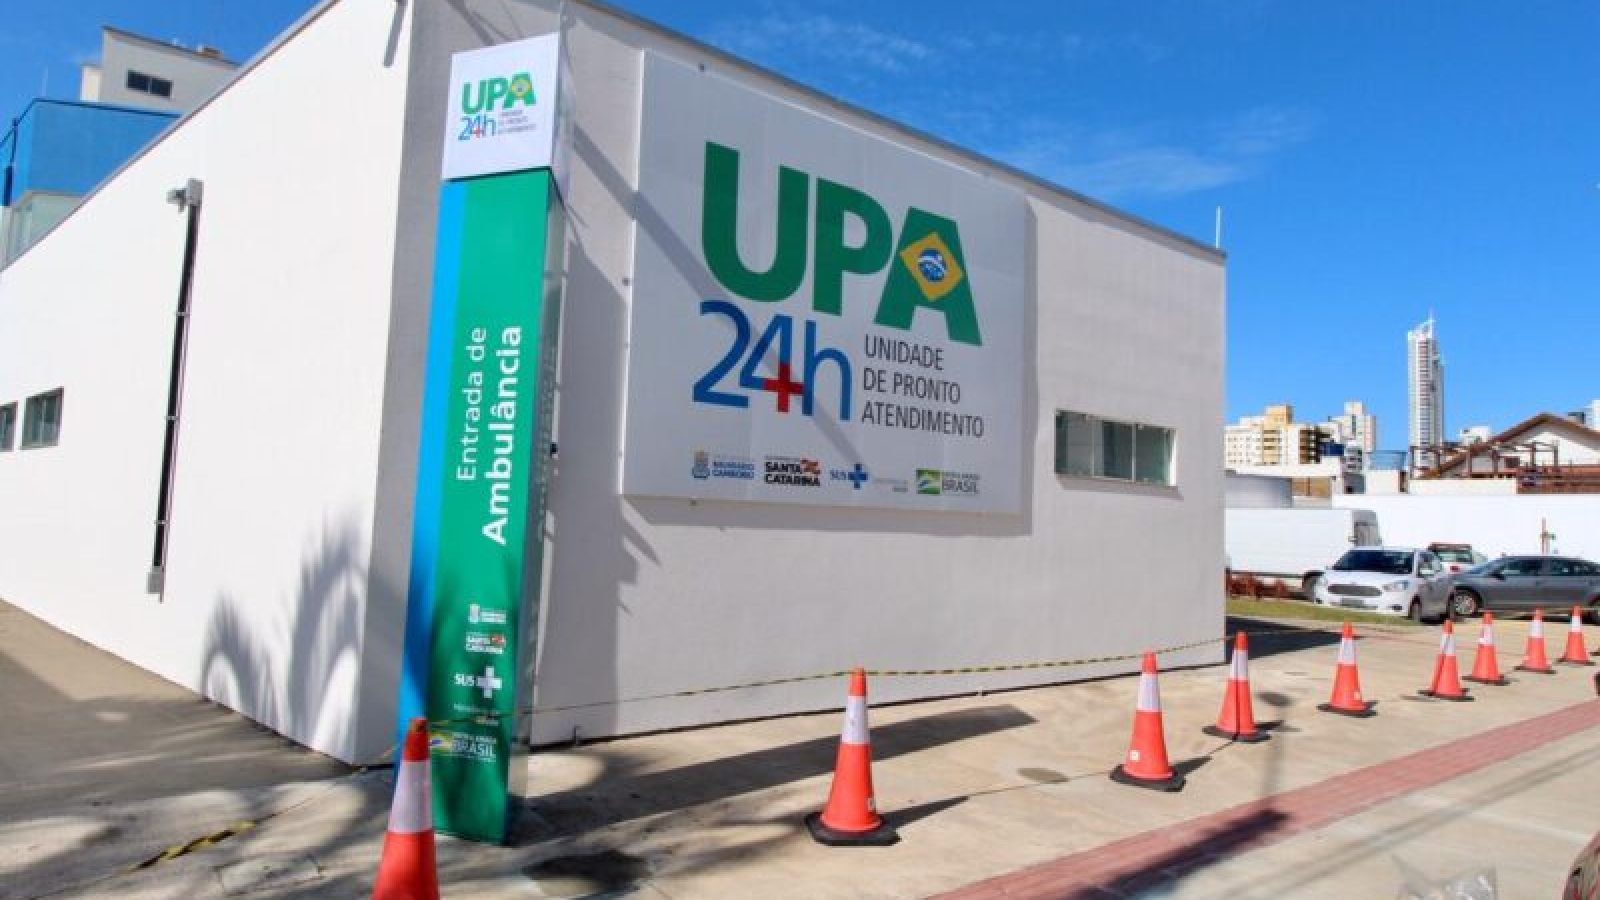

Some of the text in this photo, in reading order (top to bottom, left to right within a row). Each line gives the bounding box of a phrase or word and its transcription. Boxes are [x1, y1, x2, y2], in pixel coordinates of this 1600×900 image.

[462, 72, 536, 114] UPA
[458, 114, 497, 141] 24h
[702, 141, 982, 346] UPA
[692, 300, 852, 421] 24h
[865, 333, 944, 371] UNIDADE
[456, 327, 487, 480] Entrada de
[863, 367, 961, 404] DE PRONTO
[482, 325, 522, 546] Ambulância
[861, 401, 985, 438] ATENDIMENTO
[765, 461, 802, 474] SANTA
[765, 473, 821, 487] CATARINA
[942, 479, 979, 493] BRASIL
[454, 673, 475, 687] SUS
